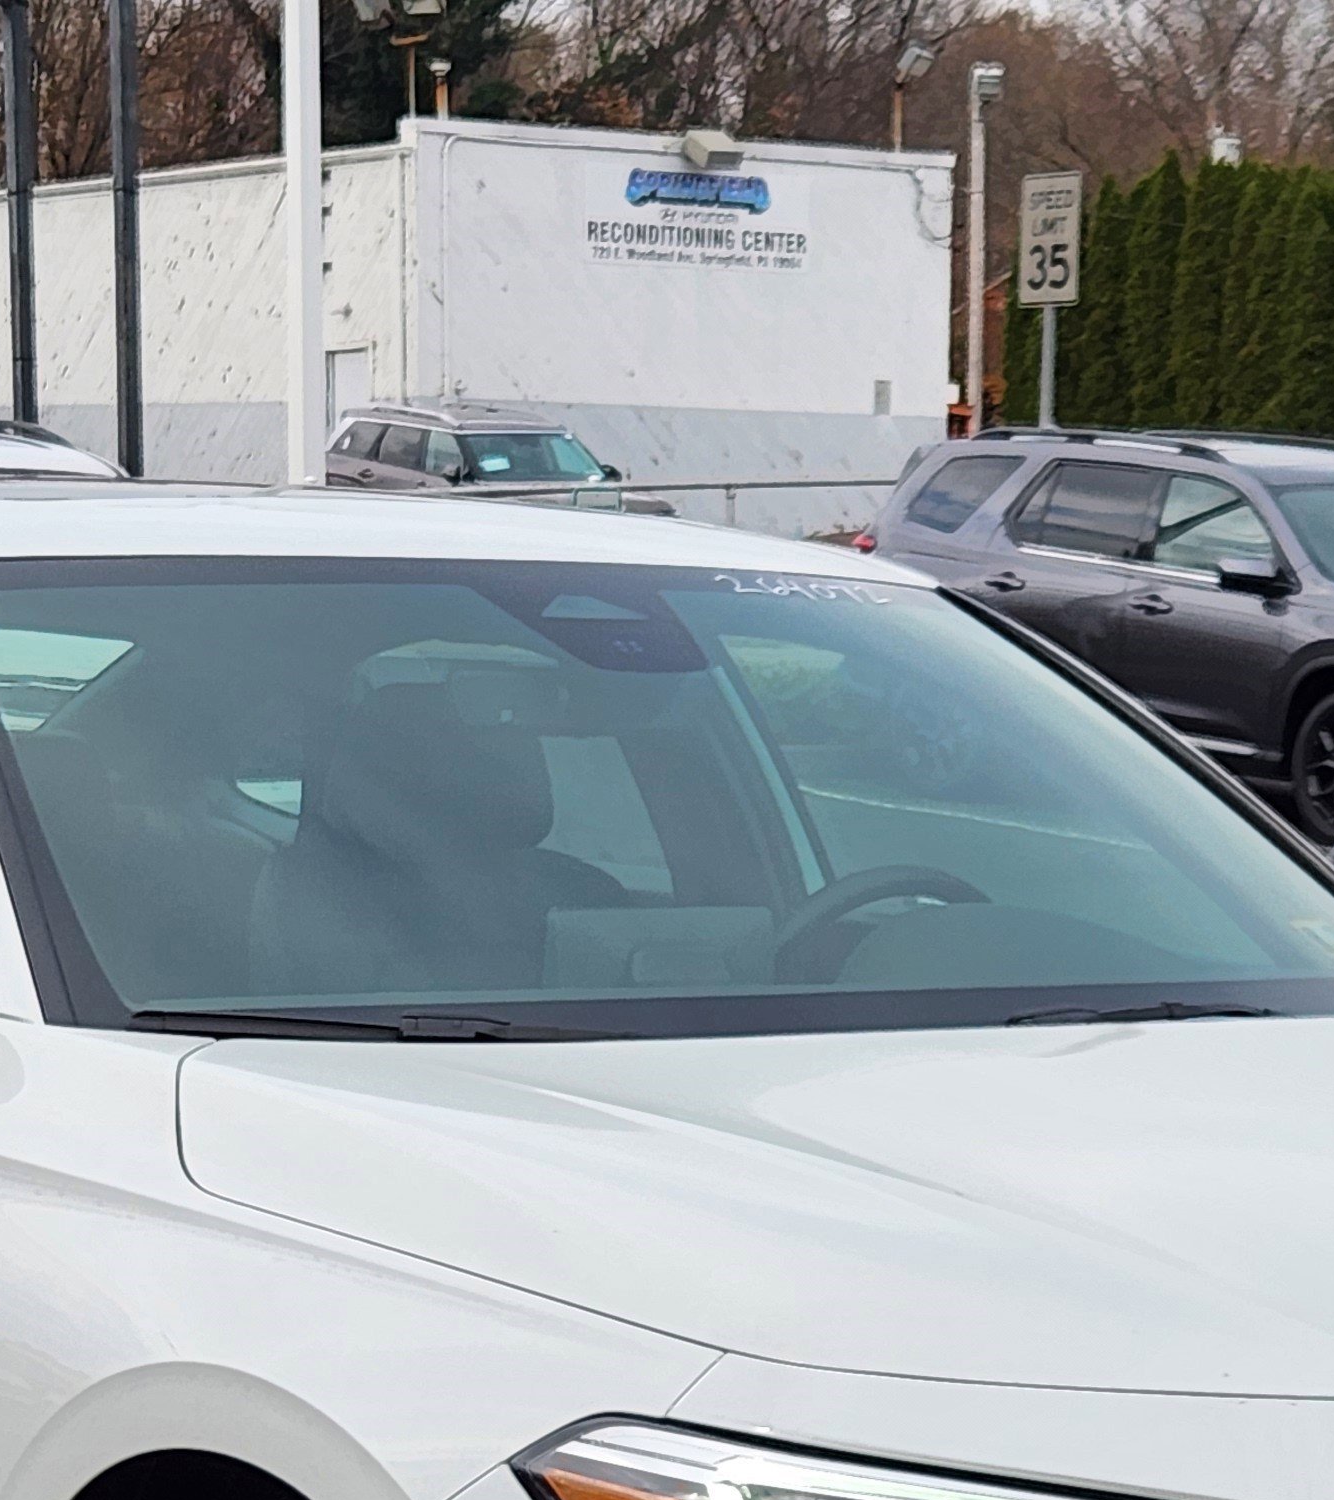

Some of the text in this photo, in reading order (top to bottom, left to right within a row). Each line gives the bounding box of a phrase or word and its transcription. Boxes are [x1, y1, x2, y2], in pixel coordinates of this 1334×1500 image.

[587, 220, 807, 254] RECONDITIONING CENTER
[1027, 243, 1071, 291] 35
